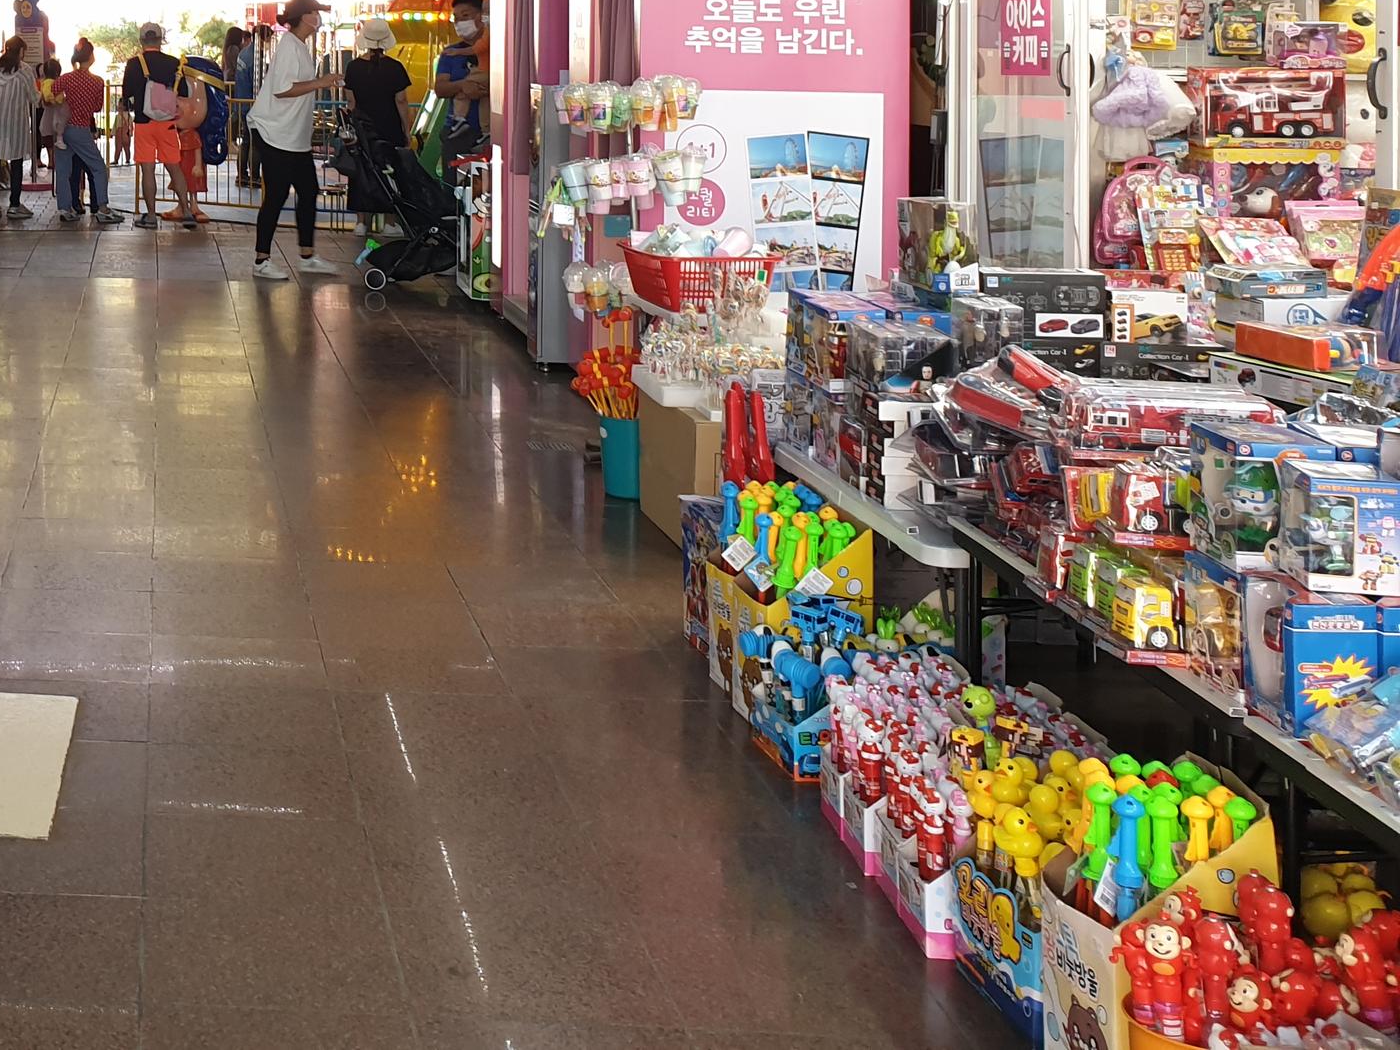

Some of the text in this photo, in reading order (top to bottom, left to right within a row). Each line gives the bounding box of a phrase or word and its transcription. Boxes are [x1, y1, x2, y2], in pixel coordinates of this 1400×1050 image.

[684, 26, 864, 56] 추억을 남긴다.
[1011, 34, 1039, 66] 커피
[686, 205, 716, 218] 리티
[955, 861, 988, 918] 오리
[1055, 947, 1098, 999] 비눗방울
